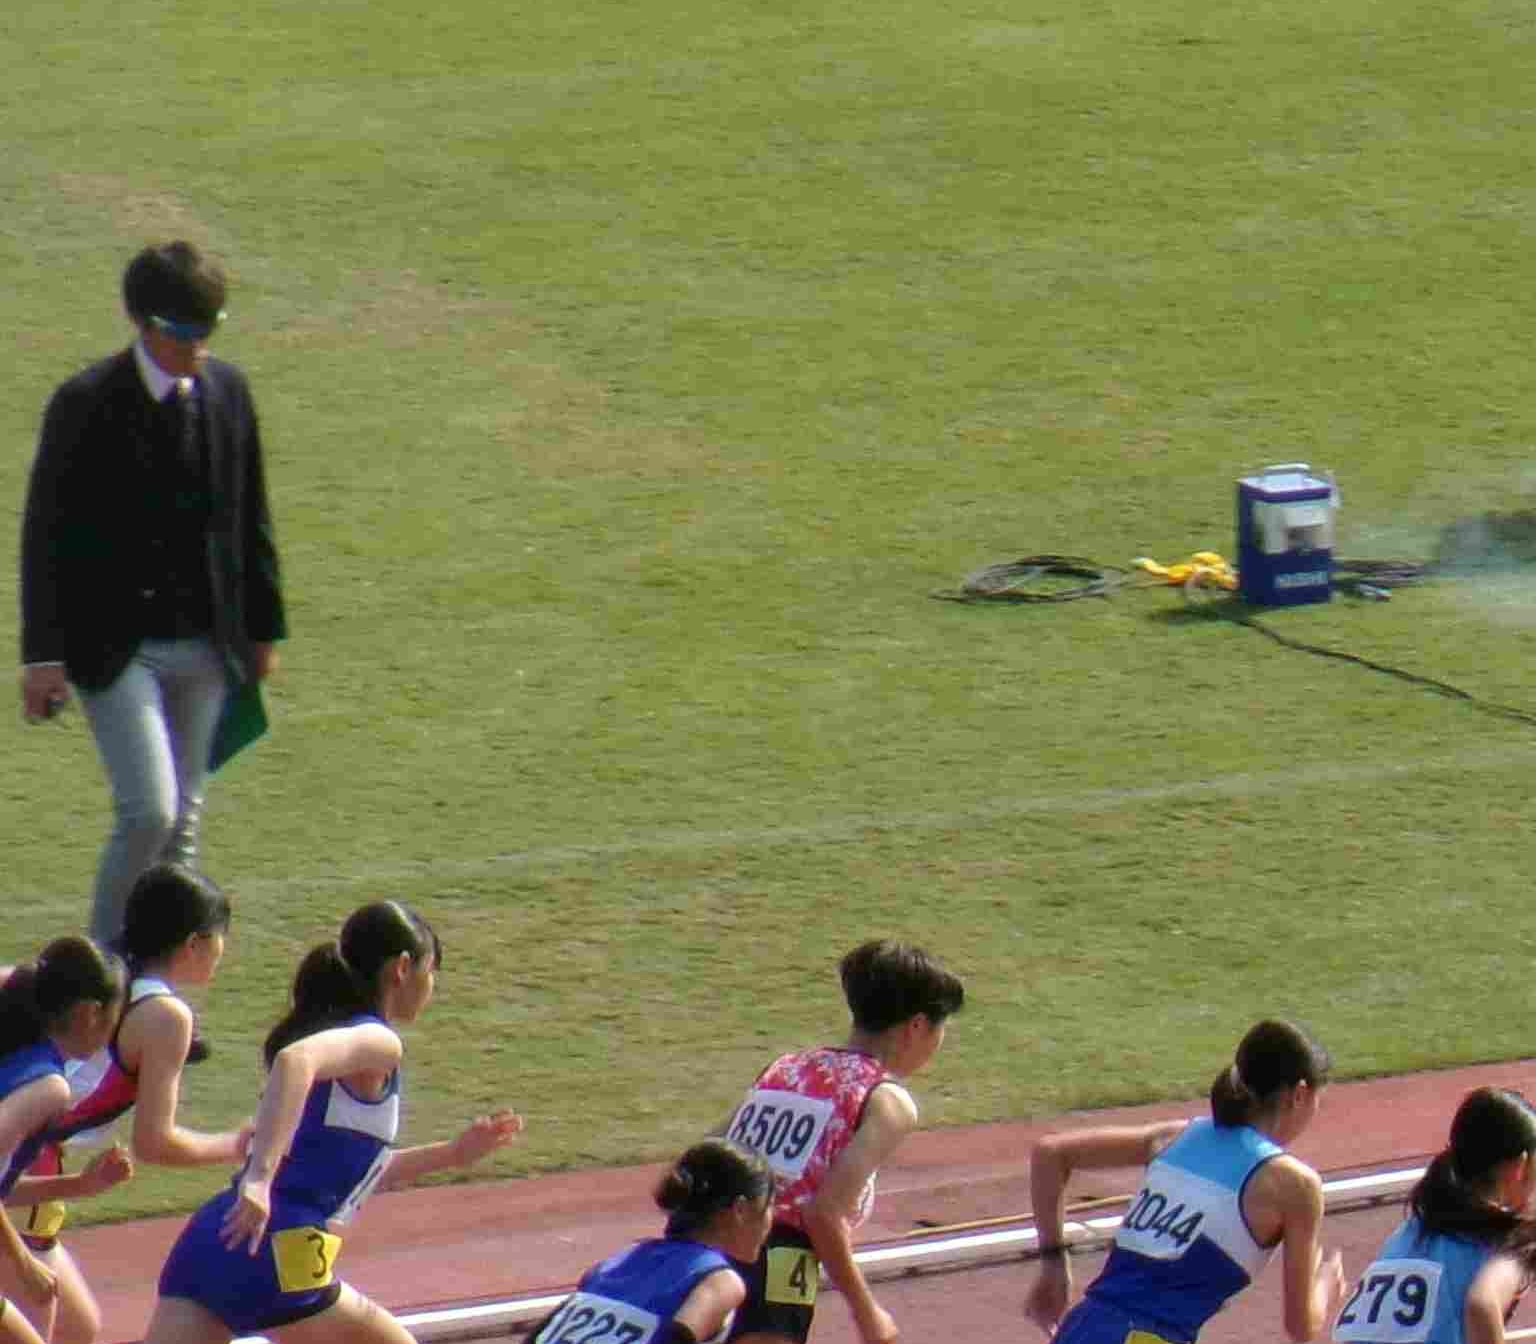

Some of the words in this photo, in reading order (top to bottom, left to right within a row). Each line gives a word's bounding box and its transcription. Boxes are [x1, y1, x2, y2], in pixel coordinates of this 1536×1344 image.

[729, 1103, 815, 1159] 8509
[307, 1232, 329, 1279] 3
[788, 1255, 807, 1298] 4
[1337, 1273, 1429, 1326] 279
